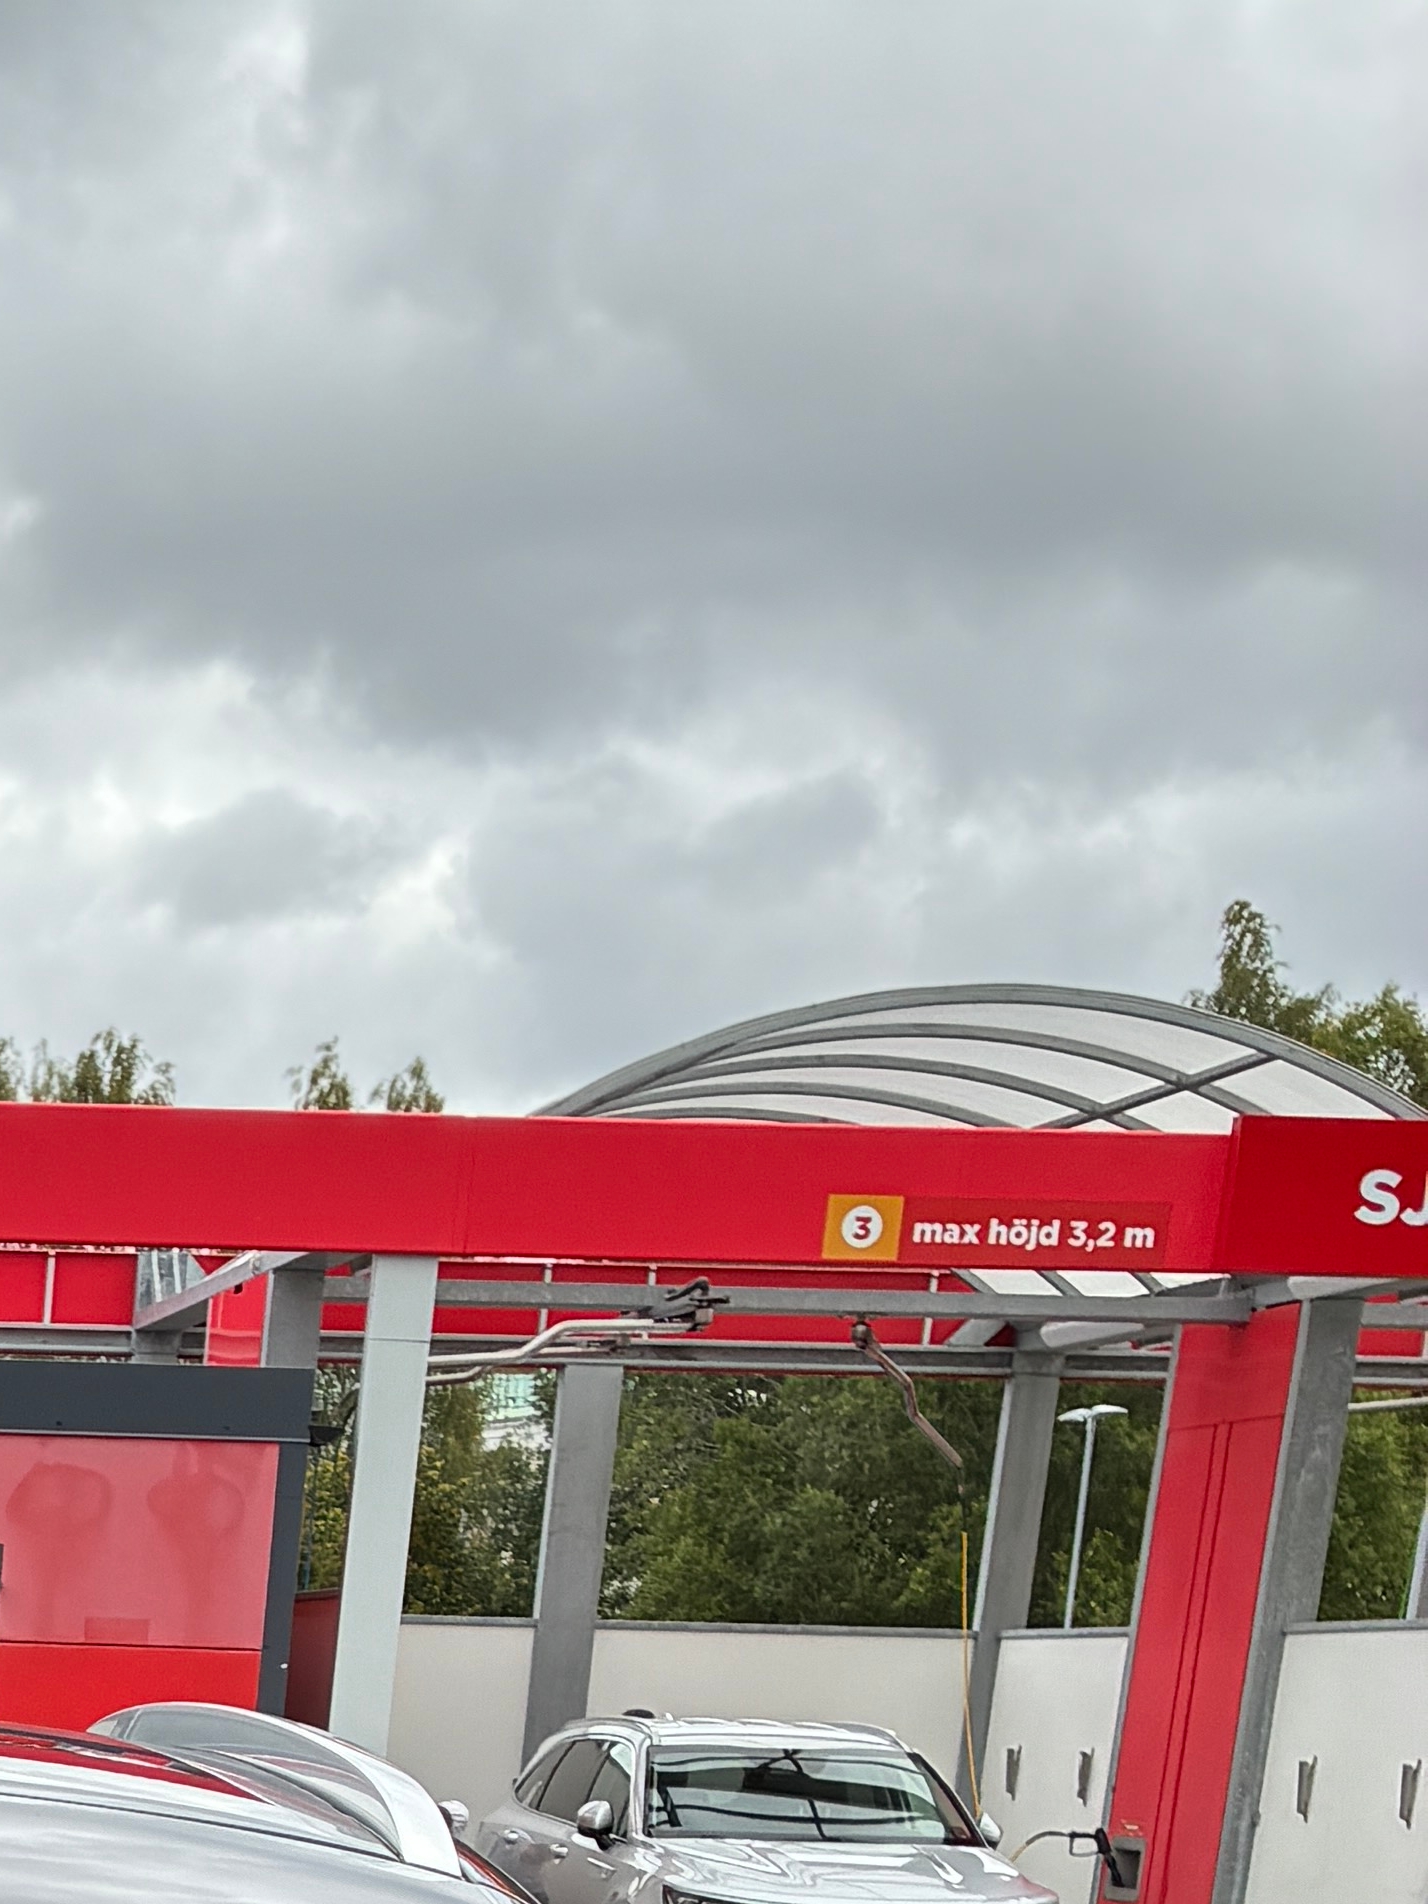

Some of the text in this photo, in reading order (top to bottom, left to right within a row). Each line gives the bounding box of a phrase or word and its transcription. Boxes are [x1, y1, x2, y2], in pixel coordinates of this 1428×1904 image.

[852, 1216, 1155, 1252] 3 max höjd 3,2 m
